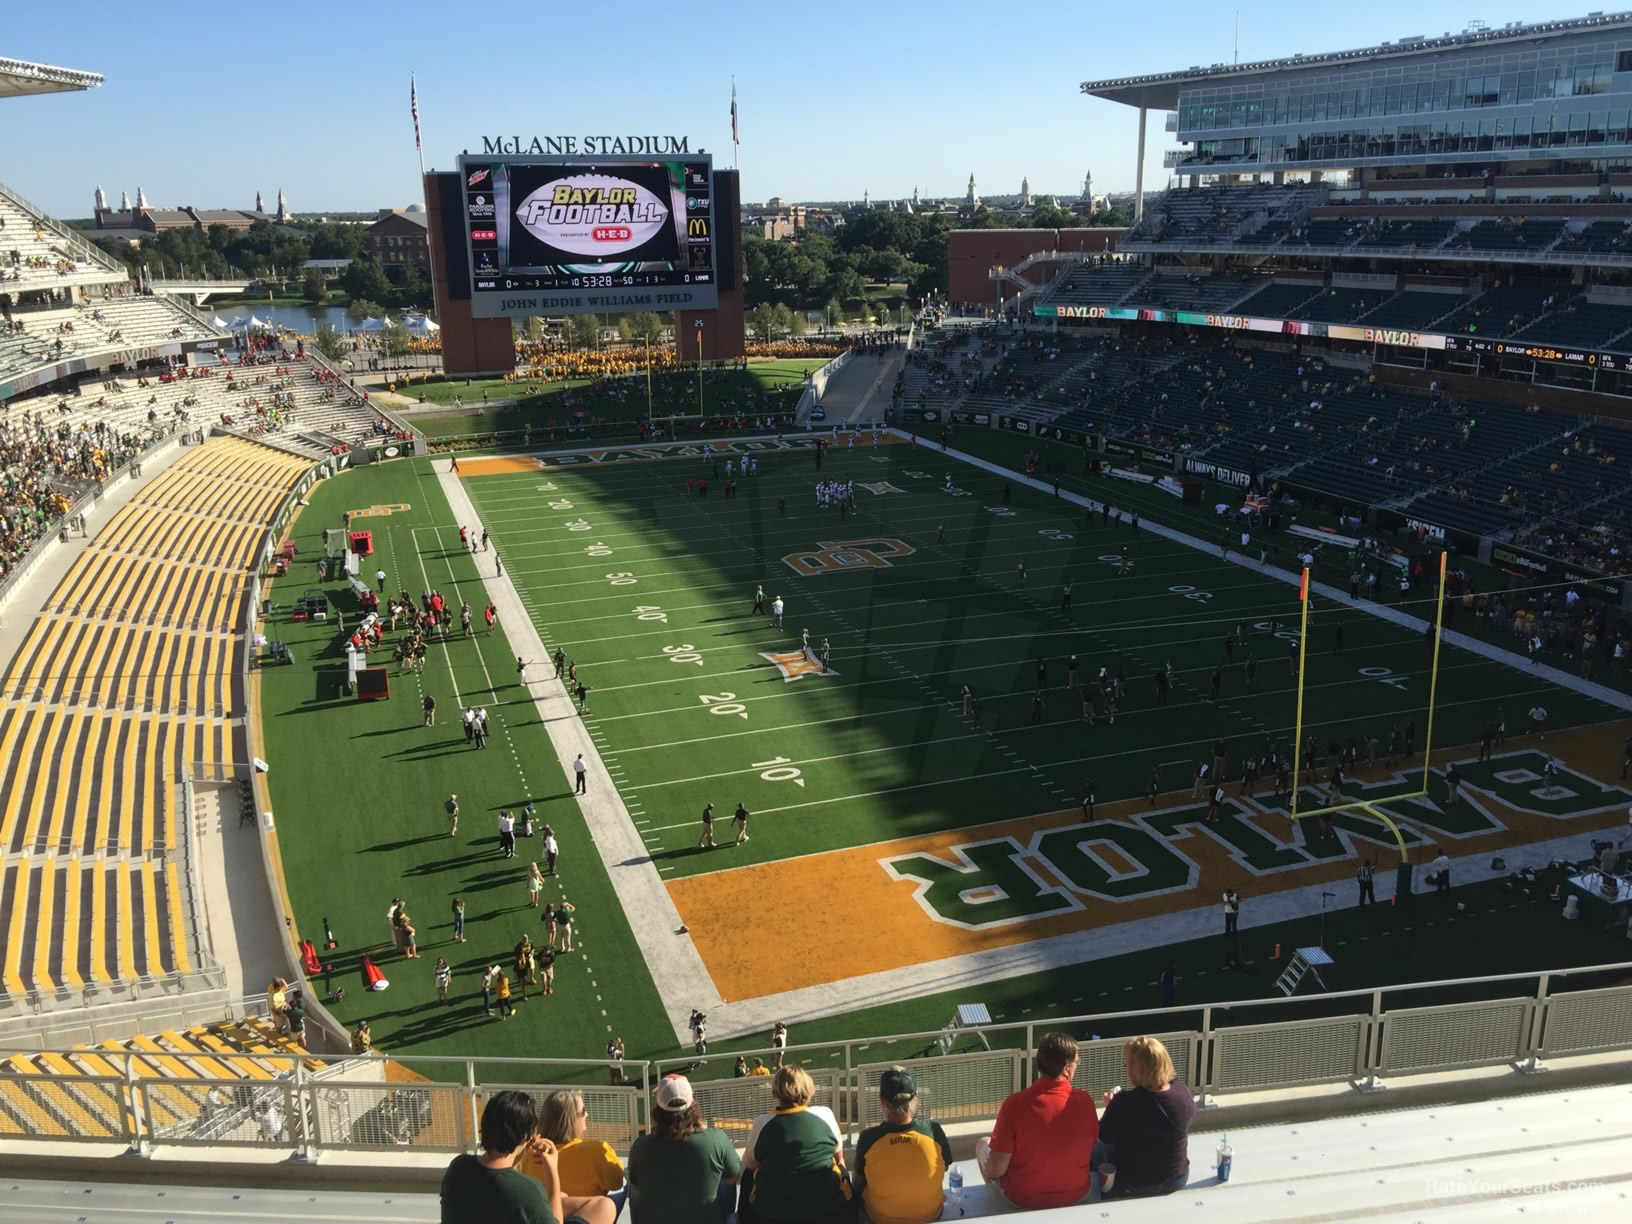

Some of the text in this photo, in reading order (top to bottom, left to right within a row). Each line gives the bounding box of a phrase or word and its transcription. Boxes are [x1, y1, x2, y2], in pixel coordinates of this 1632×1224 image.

[482, 136, 690, 154] McLANE STADIUM
[552, 185, 637, 205] BAYLOR
[526, 199, 663, 225] FOOTBALL
[506, 280, 512, 288] 0
[571, 277, 580, 287] 10
[582, 276, 613, 287] 53:28
[622, 276, 633, 285] 50
[684, 274, 690, 283] 0
[501, 292, 693, 311] JOHN EDDIE WILLIAMS FIELD
[1056, 306, 1106, 318] BAYLOR
[695, 319, 703, 327] 25
[1207, 315, 1250, 329] BAYLOR
[1364, 329, 1420, 346] BAYLOR
[111, 346, 160, 365] BAYLOR
[1497, 344, 1596, 364] 0 BAYLOR 53:28 LAMAR 0
[1185, 459, 1216, 479] ALWAYS
[565, 520, 592, 531] 30
[1038, 529, 1073, 541] 50
[584, 544, 613, 557] 40
[606, 572, 638, 585] 50
[1168, 585, 1213, 600] 30
[632, 605, 667, 621] 40
[663, 644, 703, 663] 30
[1358, 667, 1410, 685] 10
[699, 692, 746, 715] 20
[752, 756, 801, 781] 10
[876, 749, 1632, 931] BAYLOR
